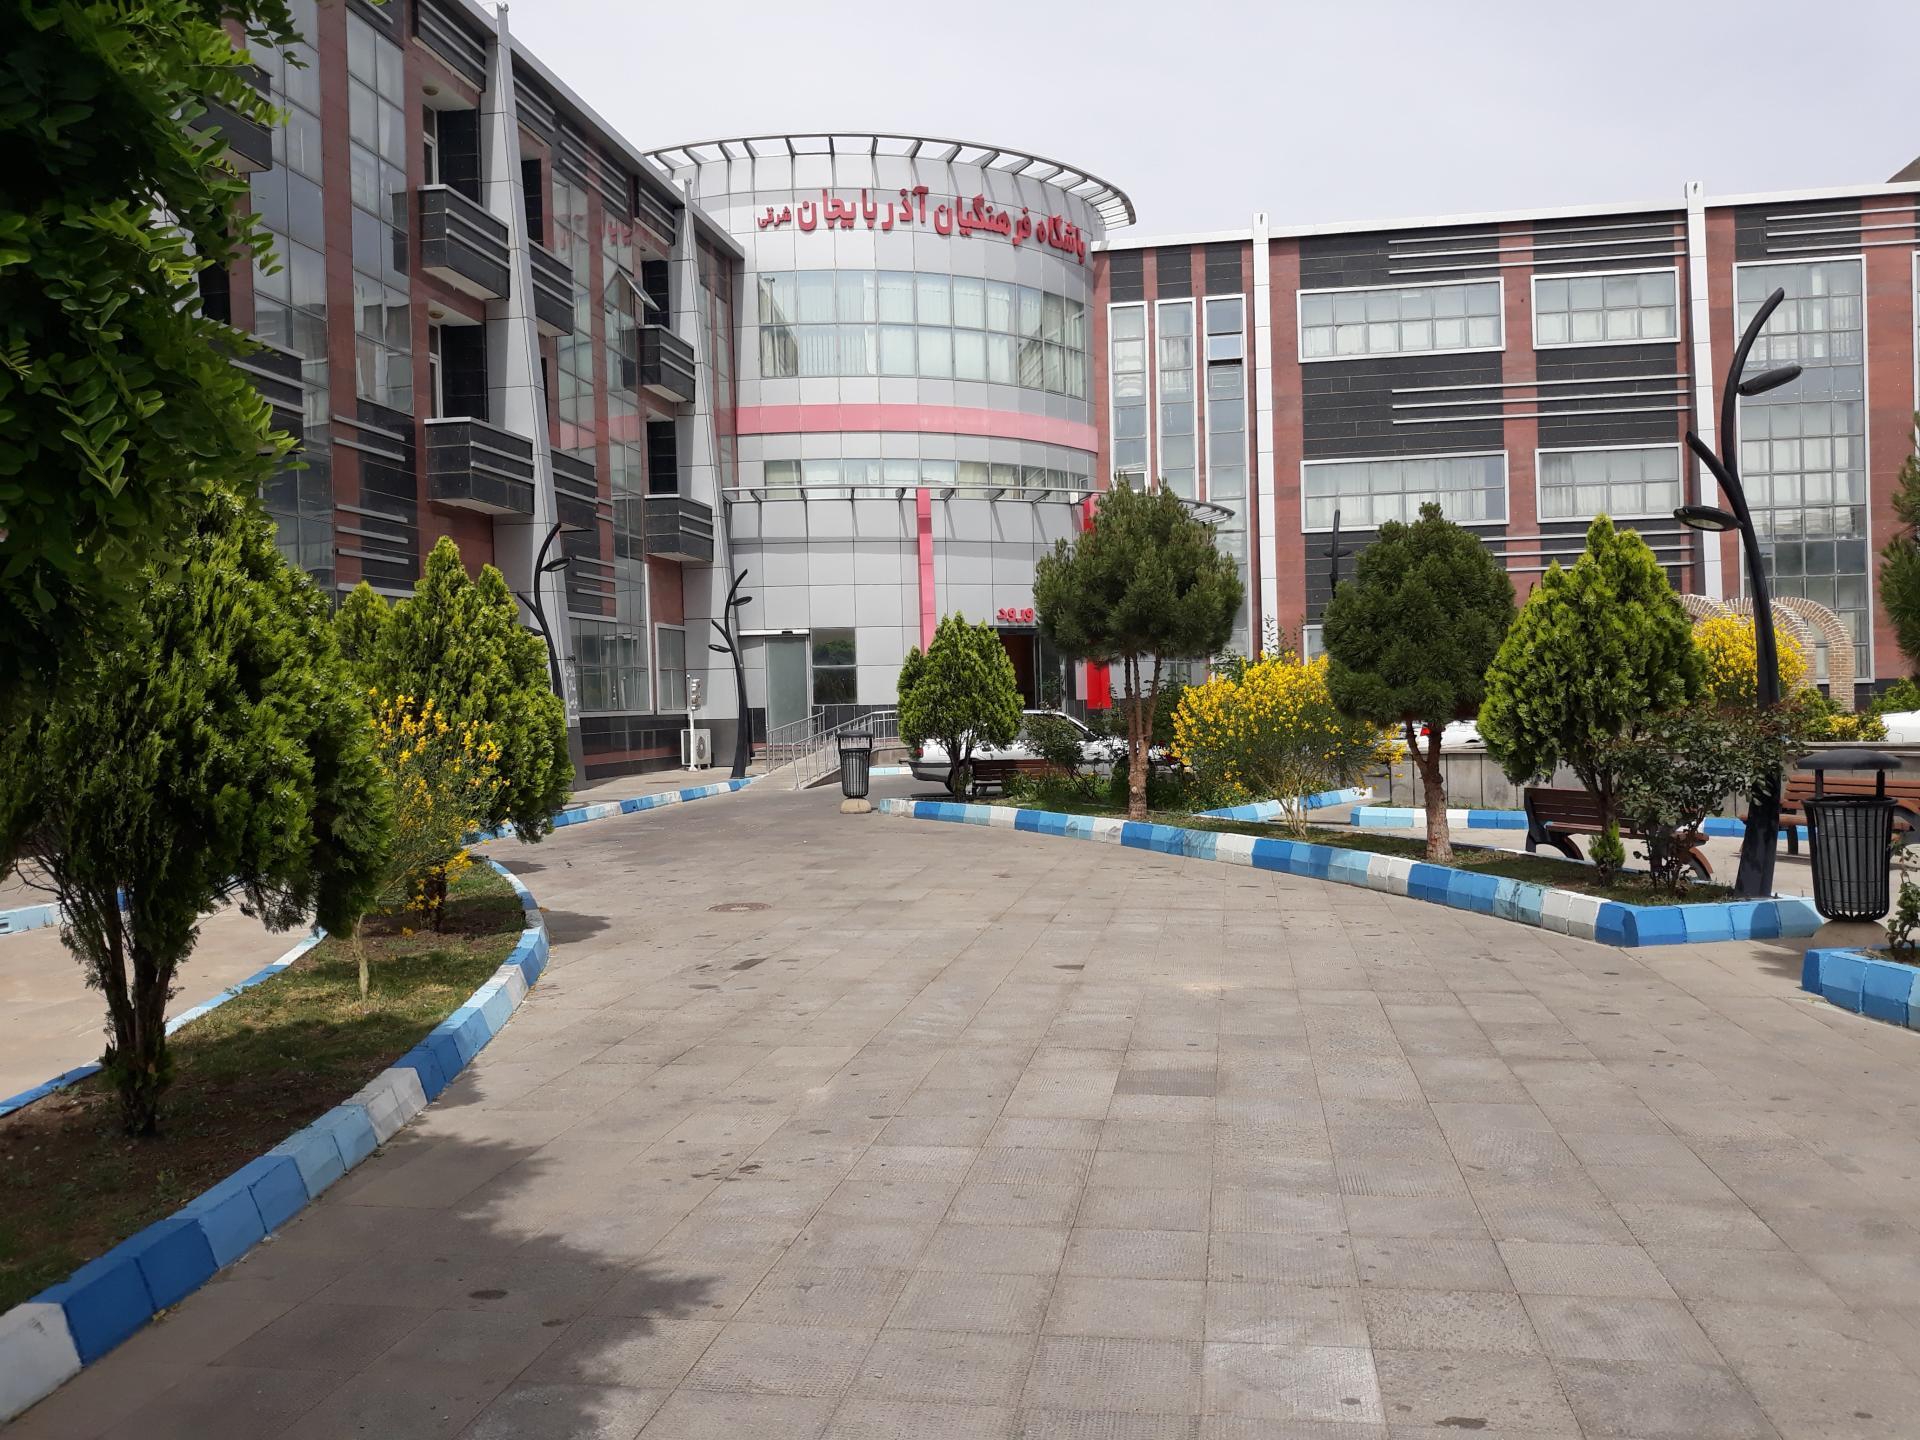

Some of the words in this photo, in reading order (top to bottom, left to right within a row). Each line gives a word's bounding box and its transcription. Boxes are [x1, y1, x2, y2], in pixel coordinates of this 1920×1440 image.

[757, 206, 792, 228] شرقی
[797, 186, 929, 231] آذربایجان
[934, 193, 1032, 247] فرهنگیان
[1036, 214, 1086, 265] باشگاه
[997, 608, 1034, 623] ورود
